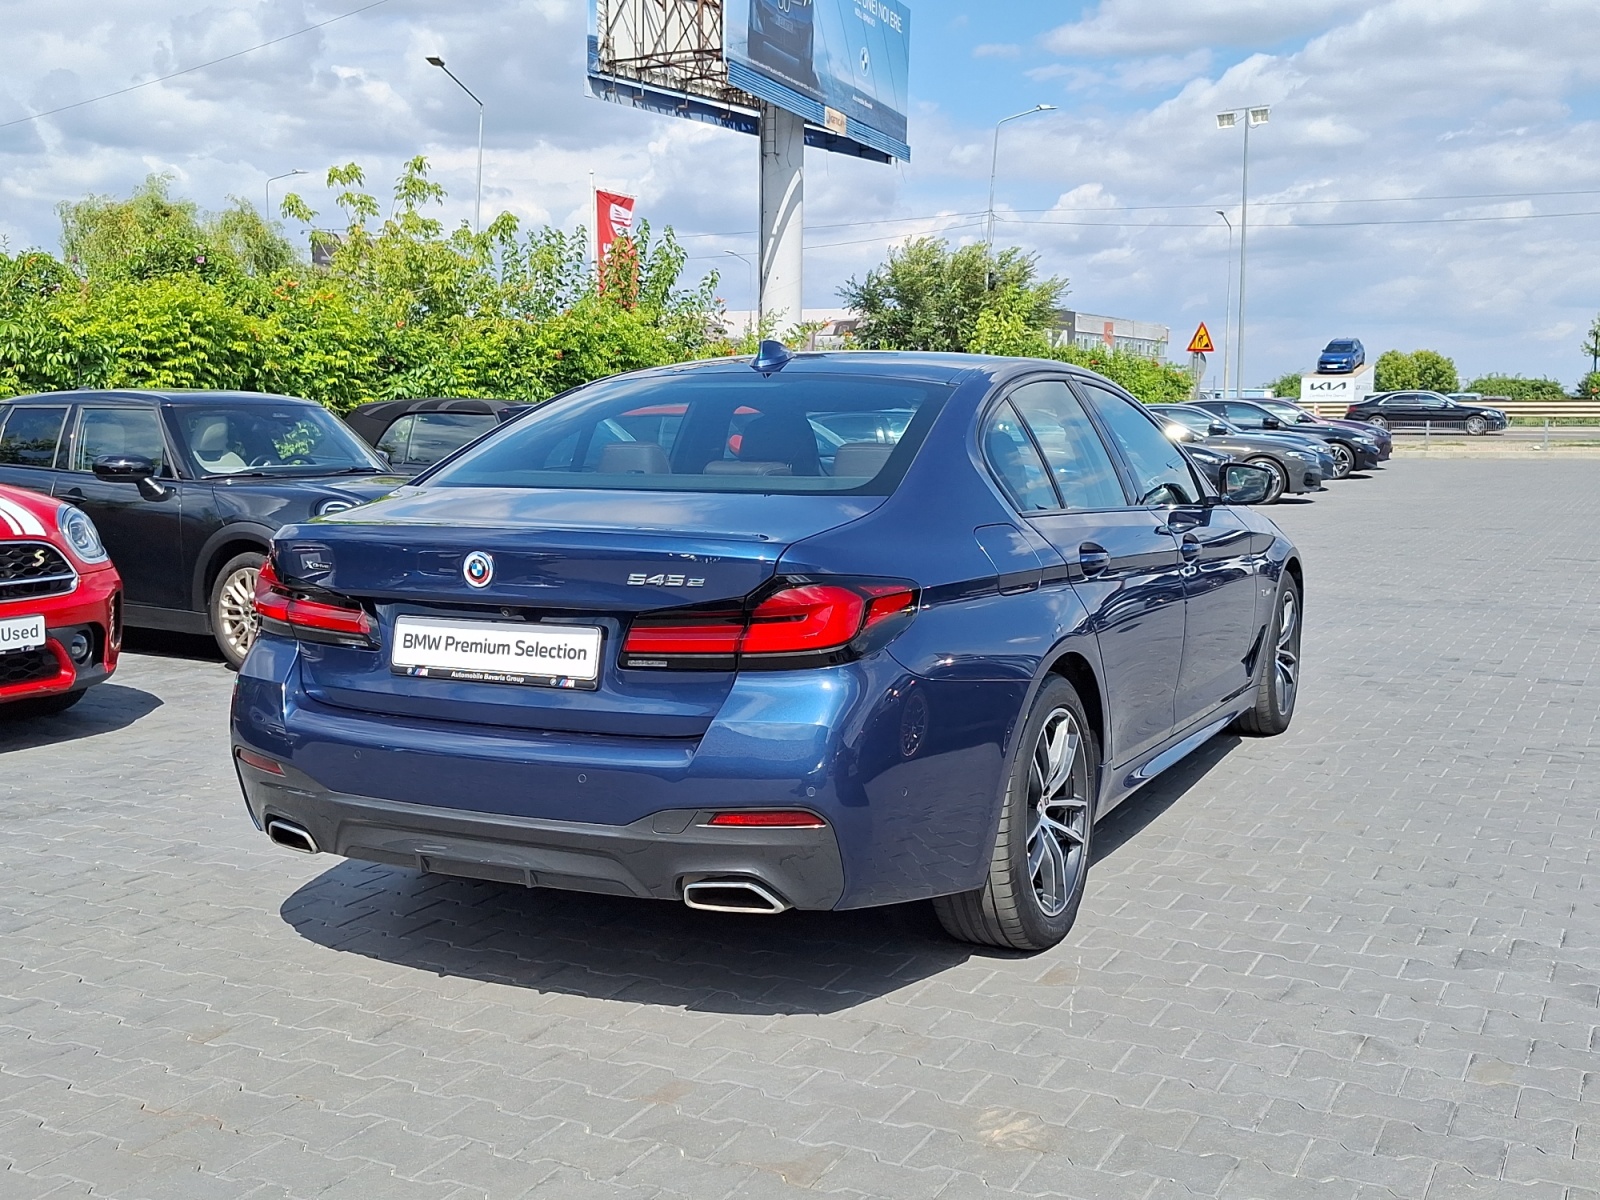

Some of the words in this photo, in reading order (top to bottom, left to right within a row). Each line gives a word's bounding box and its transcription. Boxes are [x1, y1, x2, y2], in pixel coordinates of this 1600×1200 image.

[890, 11, 902, 33] ERE
[32, 550, 44, 567] S
[1, 624, 39, 641] Used
[402, 633, 442, 650] BMW
[444, 636, 510, 655] Premium
[514, 640, 587, 660] Selection
[451, 671, 483, 680] Automobile
[506, 675, 524, 683] Group
